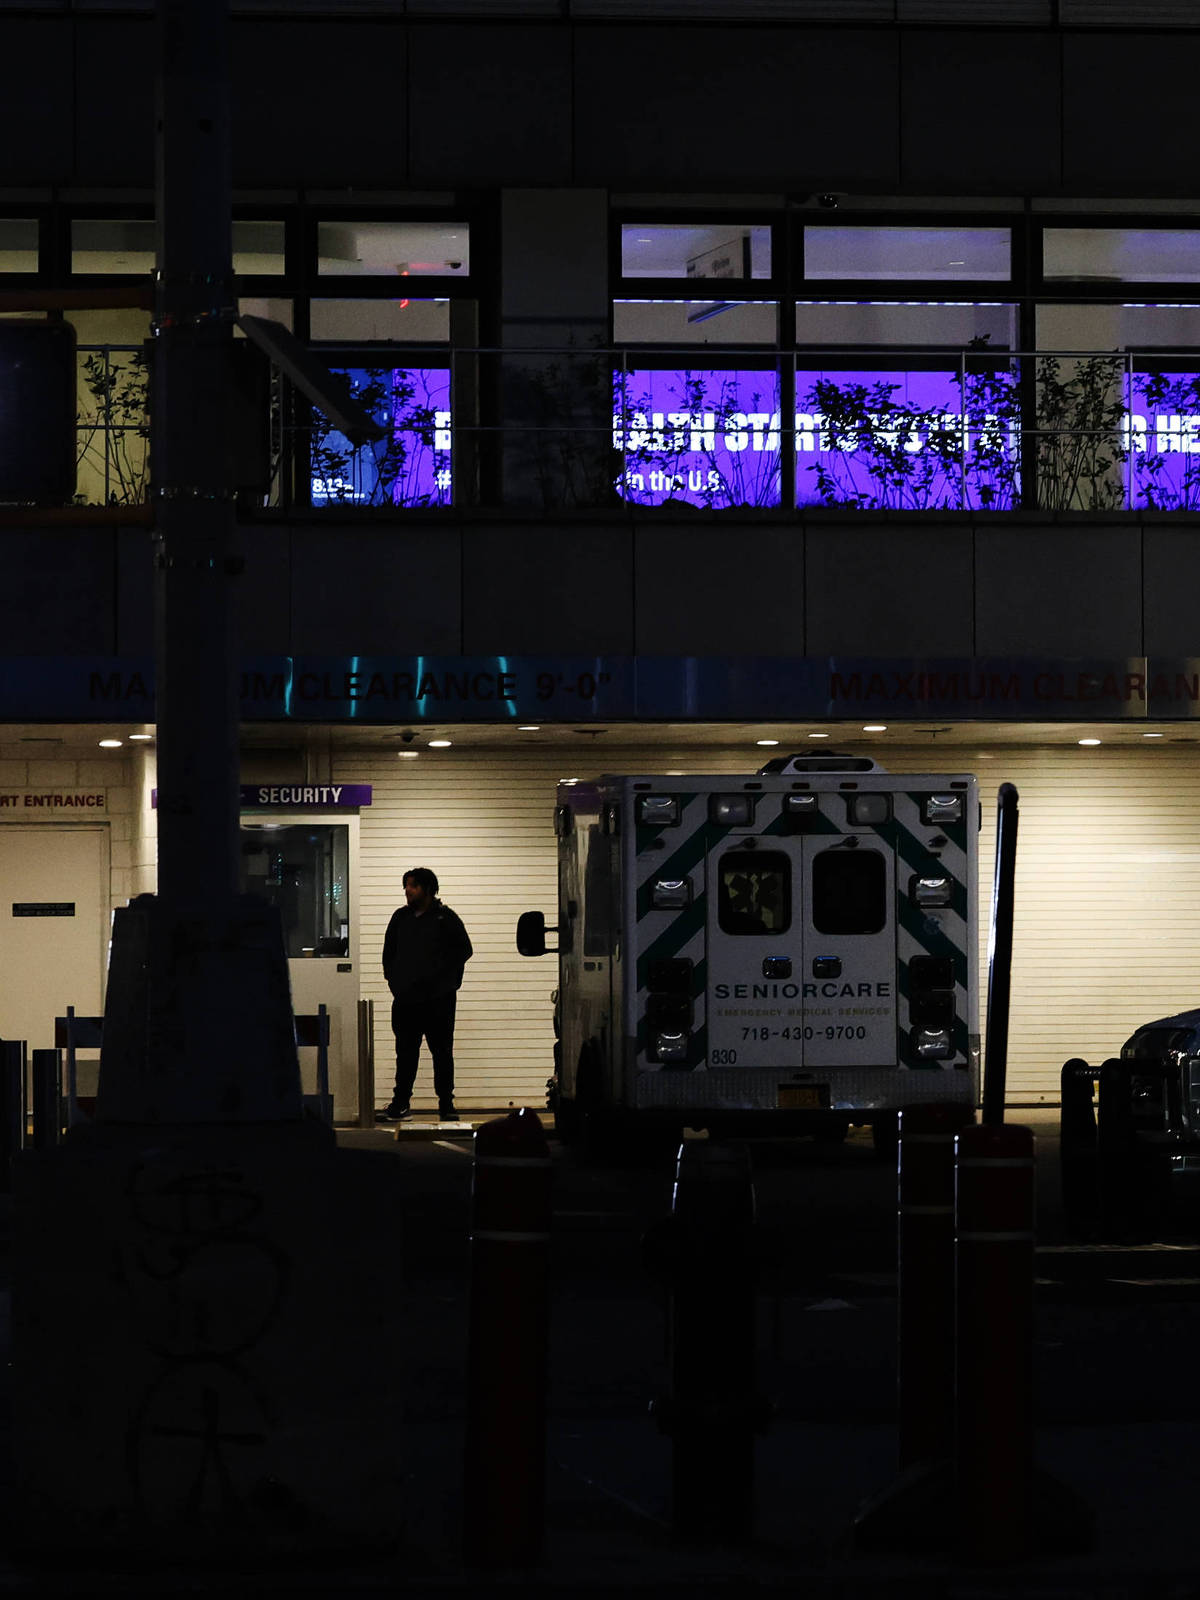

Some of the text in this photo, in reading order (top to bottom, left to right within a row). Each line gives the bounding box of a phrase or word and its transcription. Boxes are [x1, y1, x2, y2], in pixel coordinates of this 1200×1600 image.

[612, 412, 715, 451] EALTH
[649, 470, 683, 492] the
[298, 671, 517, 701] CLEARANCE
[830, 671, 1021, 701] MAXIMUM
[24, 795, 104, 807] ENTRANCE
[257, 786, 343, 805] SECURITY
[714, 982, 891, 999] SENIORCARE
[716, 1007, 782, 1018] EMERGENCY
[741, 1026, 867, 1041] 718-430-9700
[711, 1049, 738, 1065] 830
